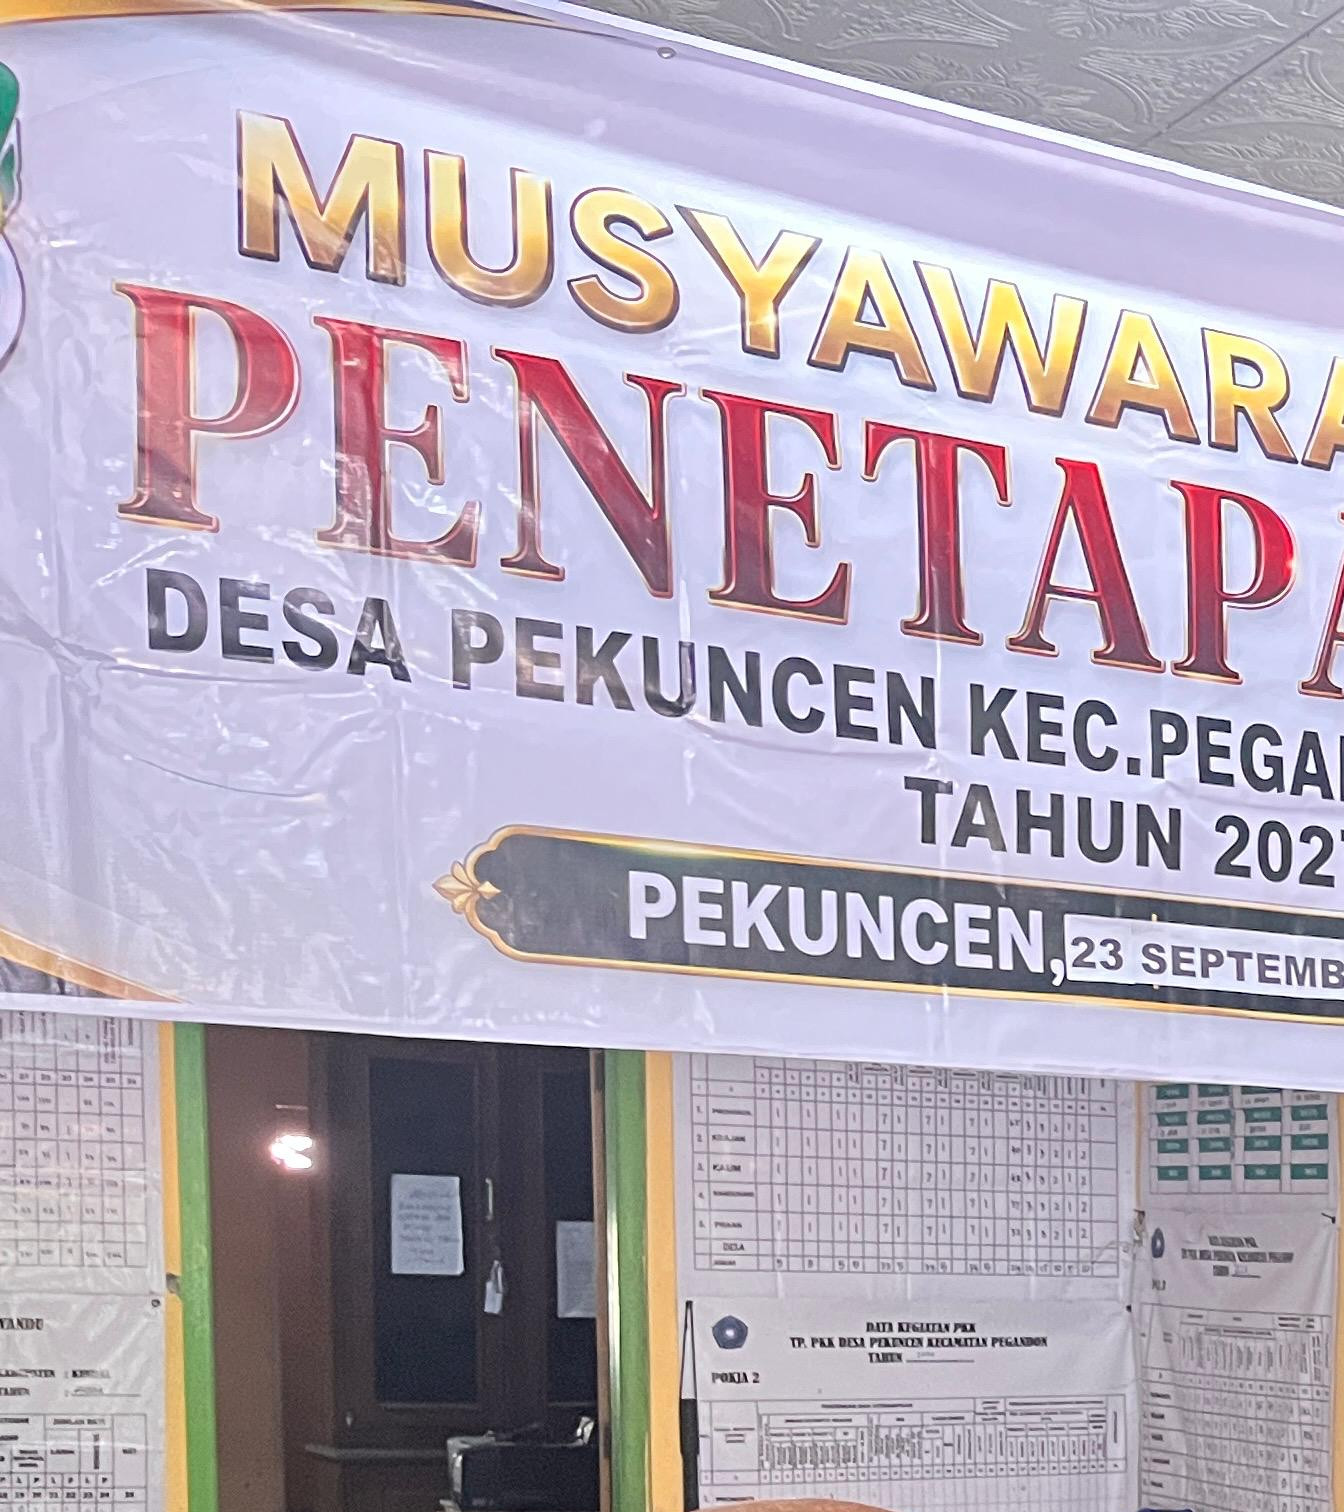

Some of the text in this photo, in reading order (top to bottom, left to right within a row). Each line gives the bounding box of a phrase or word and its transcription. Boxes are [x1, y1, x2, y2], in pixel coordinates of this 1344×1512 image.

[145, 567, 408, 684] DESA
[450, 607, 937, 751] PEKUNCEN
[904, 774, 1182, 871] TAHUN
[628, 870, 1065, 988] PEKUNCEN,
[1071, 935, 1124, 971] 23
[751, 1371, 760, 1384] 2
